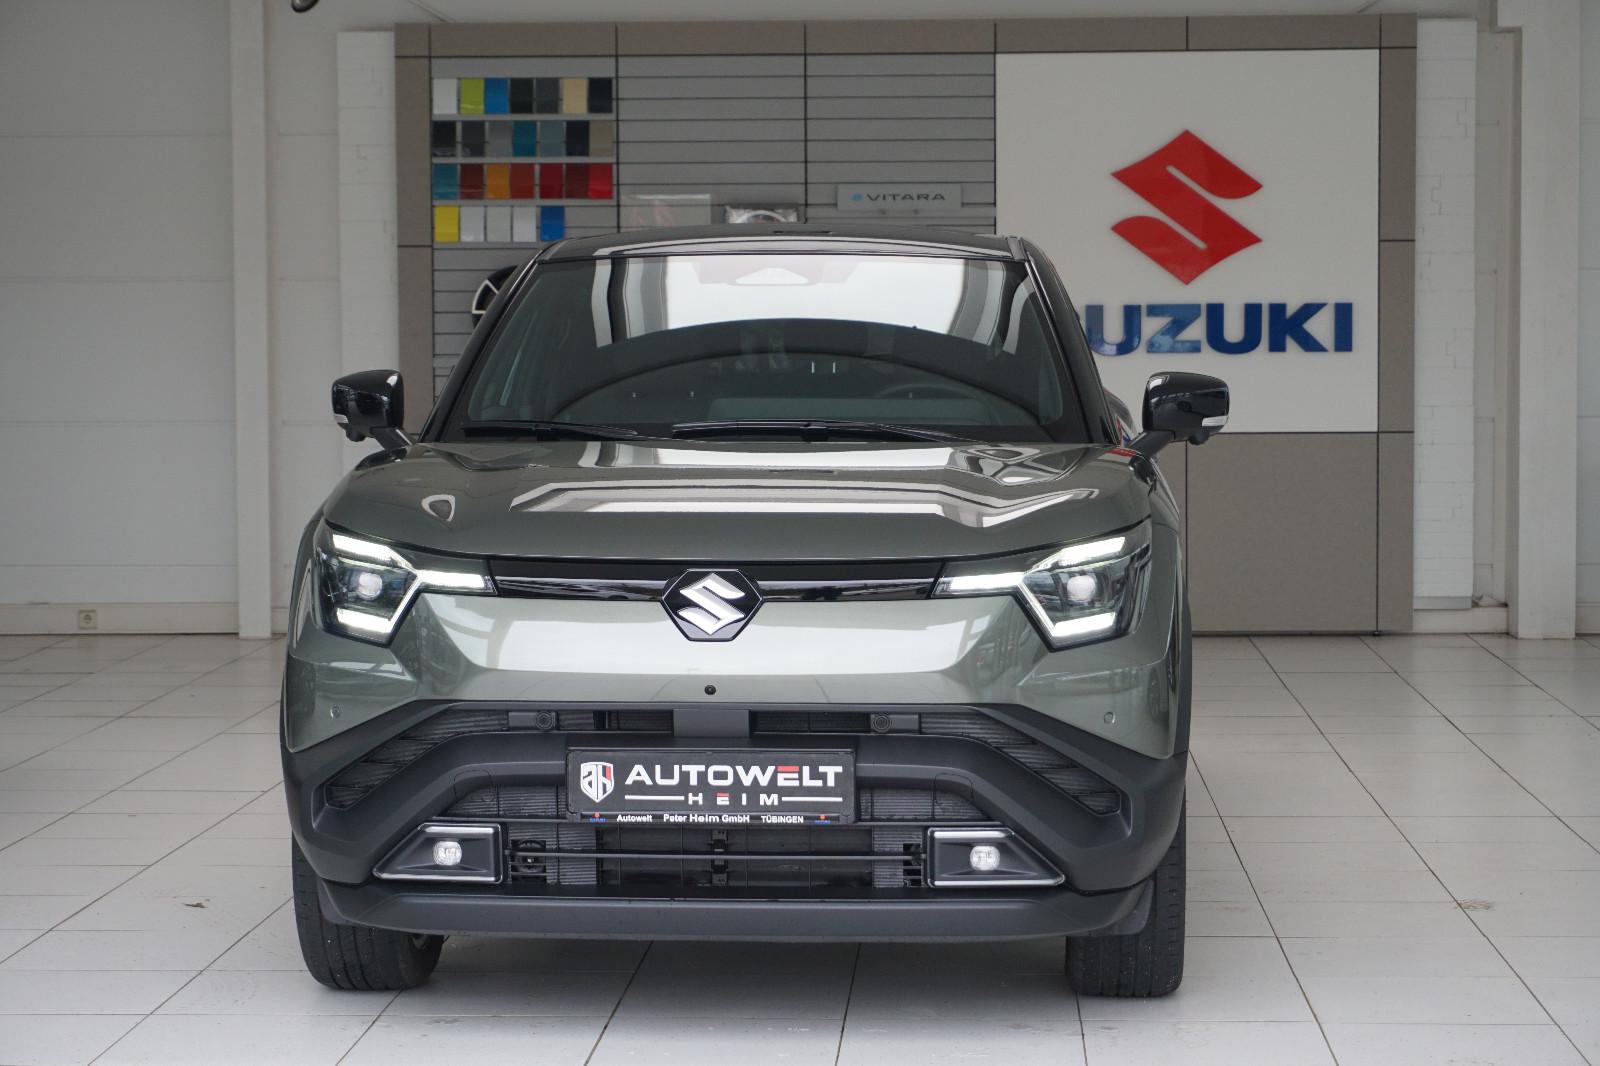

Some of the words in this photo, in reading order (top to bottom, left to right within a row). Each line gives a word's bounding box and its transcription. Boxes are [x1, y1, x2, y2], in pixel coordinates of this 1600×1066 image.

[866, 193, 946, 202] VITARA
[1084, 302, 1354, 356] UZUKI
[624, 764, 844, 787] AUTOWELT
[687, 792, 780, 807] HEIM
[616, 813, 653, 823] Autowelt
[663, 813, 688, 823] Peter
[689, 813, 720, 823] Heim
[721, 814, 751, 824] GmbH
[760, 814, 805, 824] TÜBINGEN
